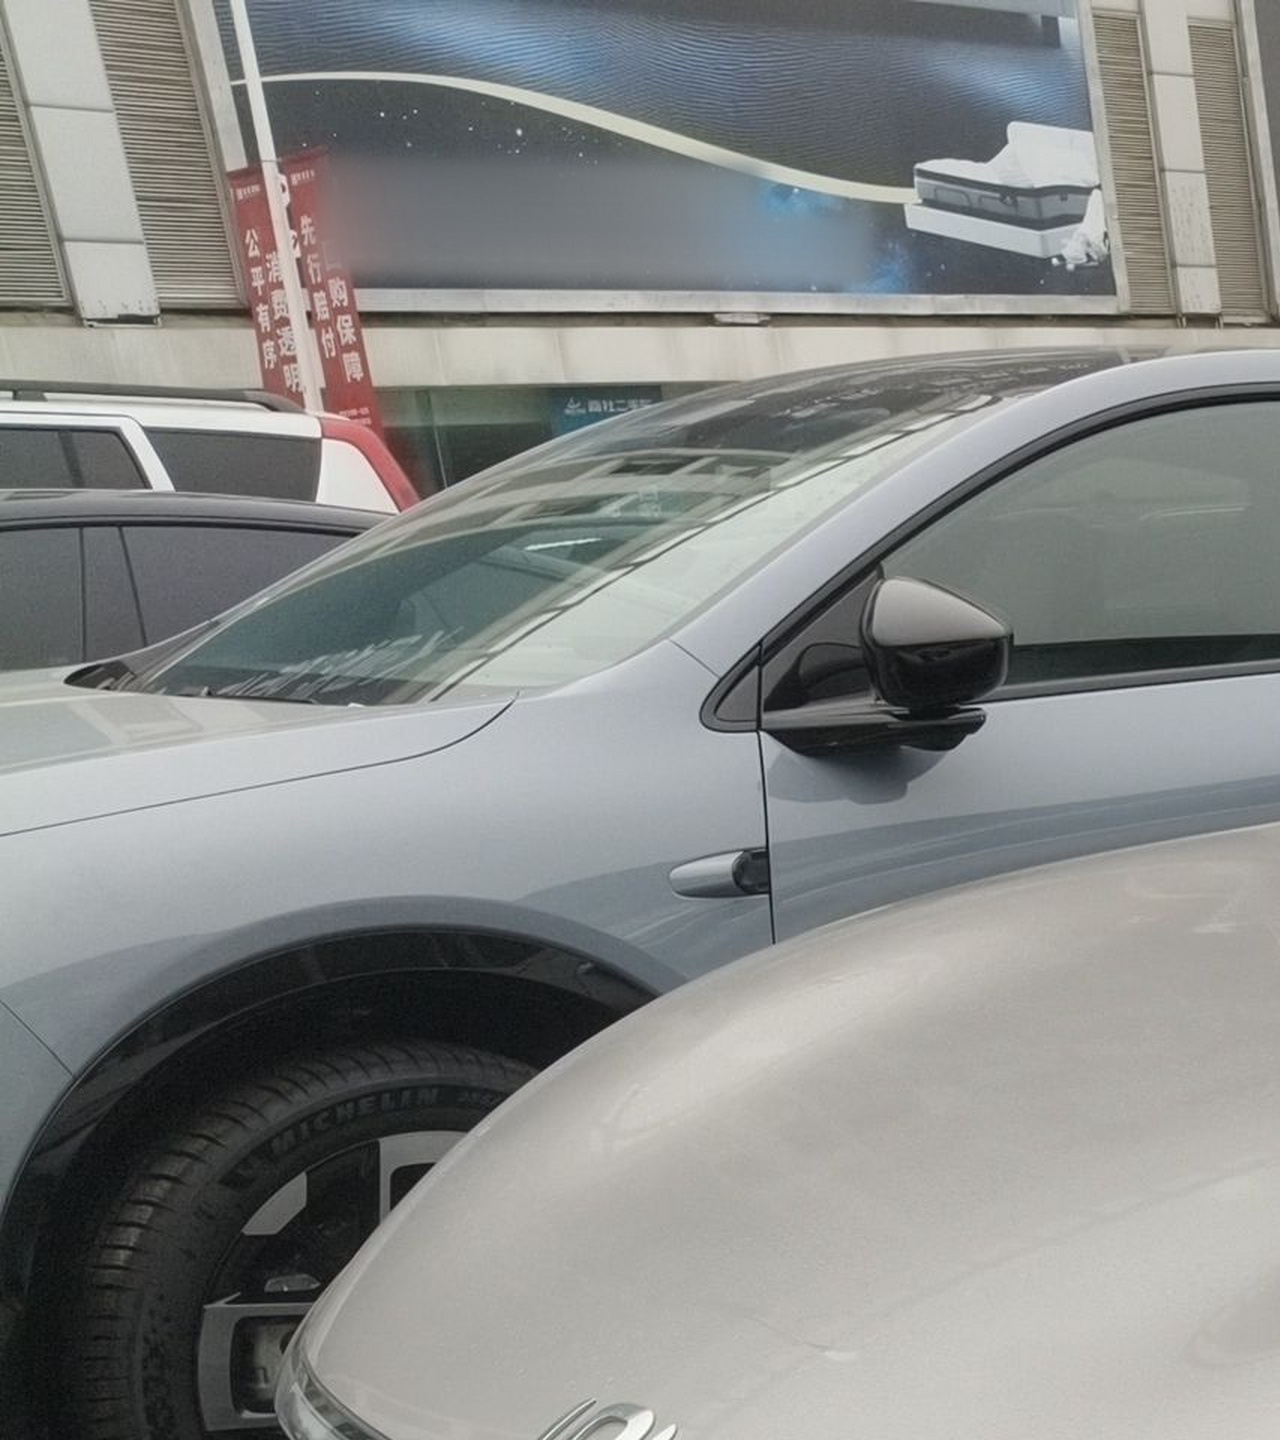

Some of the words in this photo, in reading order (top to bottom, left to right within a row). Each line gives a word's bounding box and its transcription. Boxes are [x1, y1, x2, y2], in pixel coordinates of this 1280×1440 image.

[245, 228, 277, 370] 公平有序
[300, 214, 336, 359] 先行赔付
[323, 242, 364, 384] 购保障
[270, 1087, 438, 1151] MICHELIN
